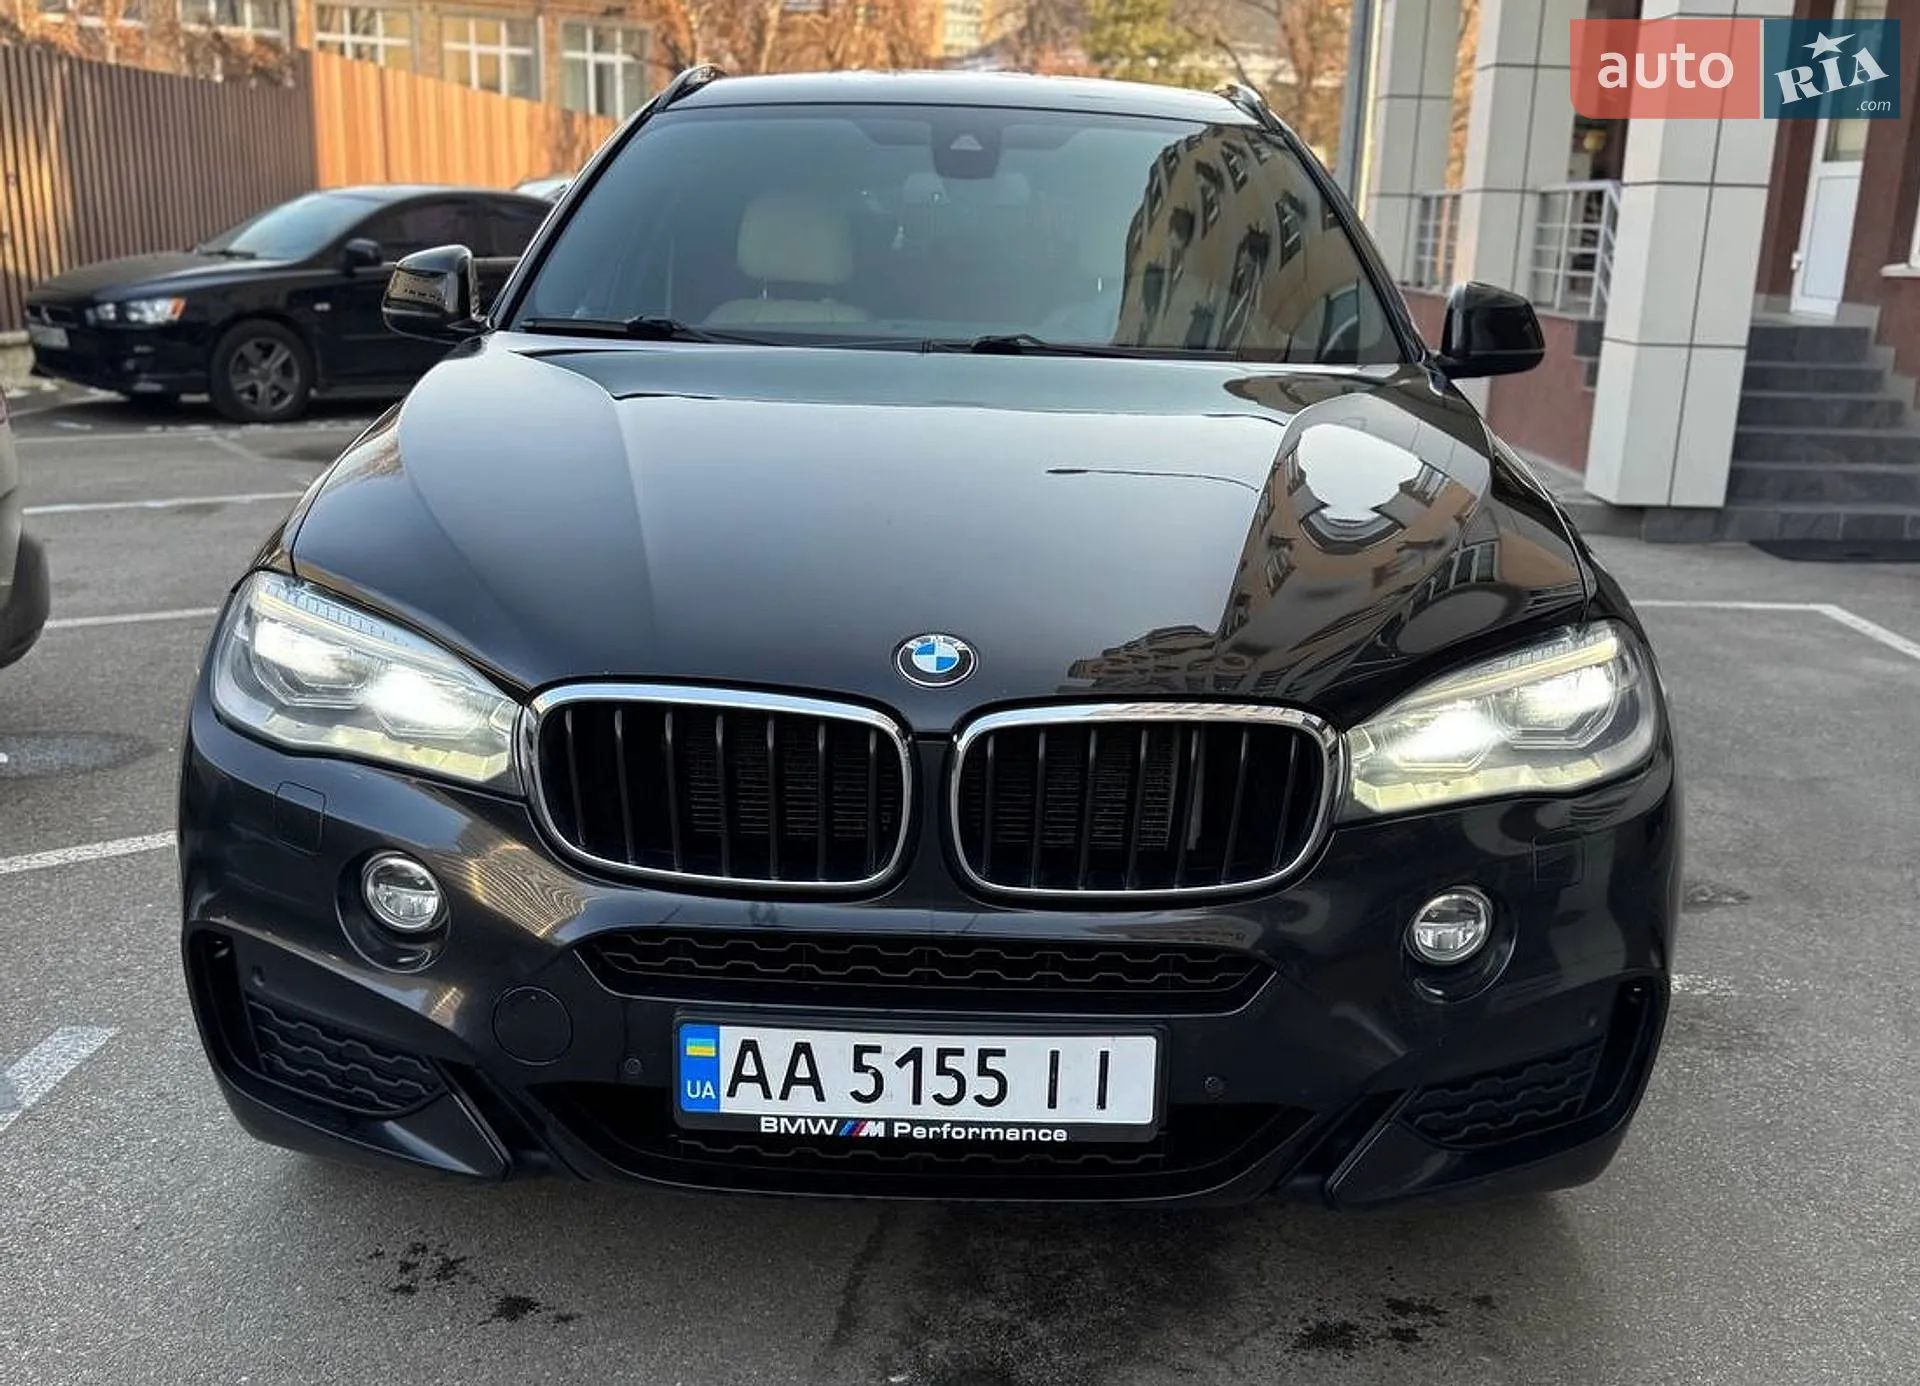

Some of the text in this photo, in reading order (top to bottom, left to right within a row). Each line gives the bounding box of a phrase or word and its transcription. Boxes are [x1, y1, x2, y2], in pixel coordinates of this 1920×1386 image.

[726, 1038, 1109, 1109] AA 5155 II
[686, 1079, 716, 1100] UA
[760, 1116, 838, 1136] BMW
[893, 1121, 1068, 1142] Performance
